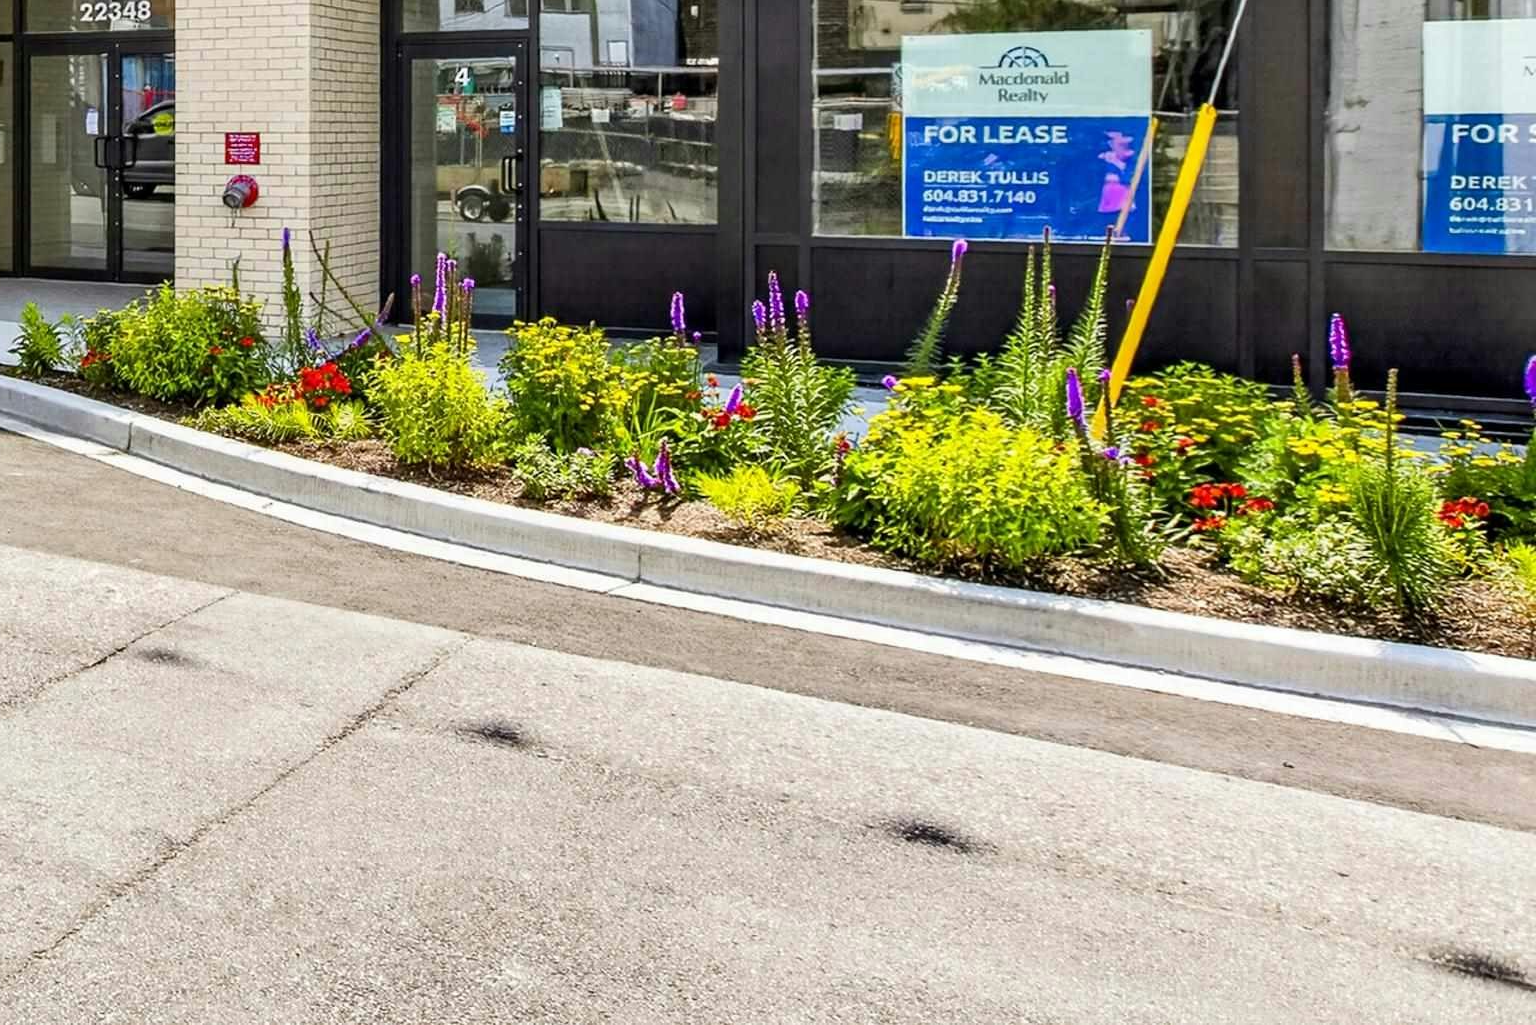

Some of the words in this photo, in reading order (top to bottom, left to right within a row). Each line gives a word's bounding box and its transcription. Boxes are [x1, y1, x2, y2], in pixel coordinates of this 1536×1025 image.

[80, 0, 152, 22] 22348
[454, 67, 472, 88] 4
[978, 71, 1070, 87] Macdonald
[997, 88, 1049, 104] Realty
[923, 125, 977, 144] FOR
[983, 125, 1069, 144] LEASE
[1451, 123, 1520, 144] FOR
[923, 170, 984, 184] DEREK
[985, 171, 1050, 185] TULLIS
[1450, 175, 1528, 190] DEREK
[923, 189, 1036, 204] 604.831.7140
